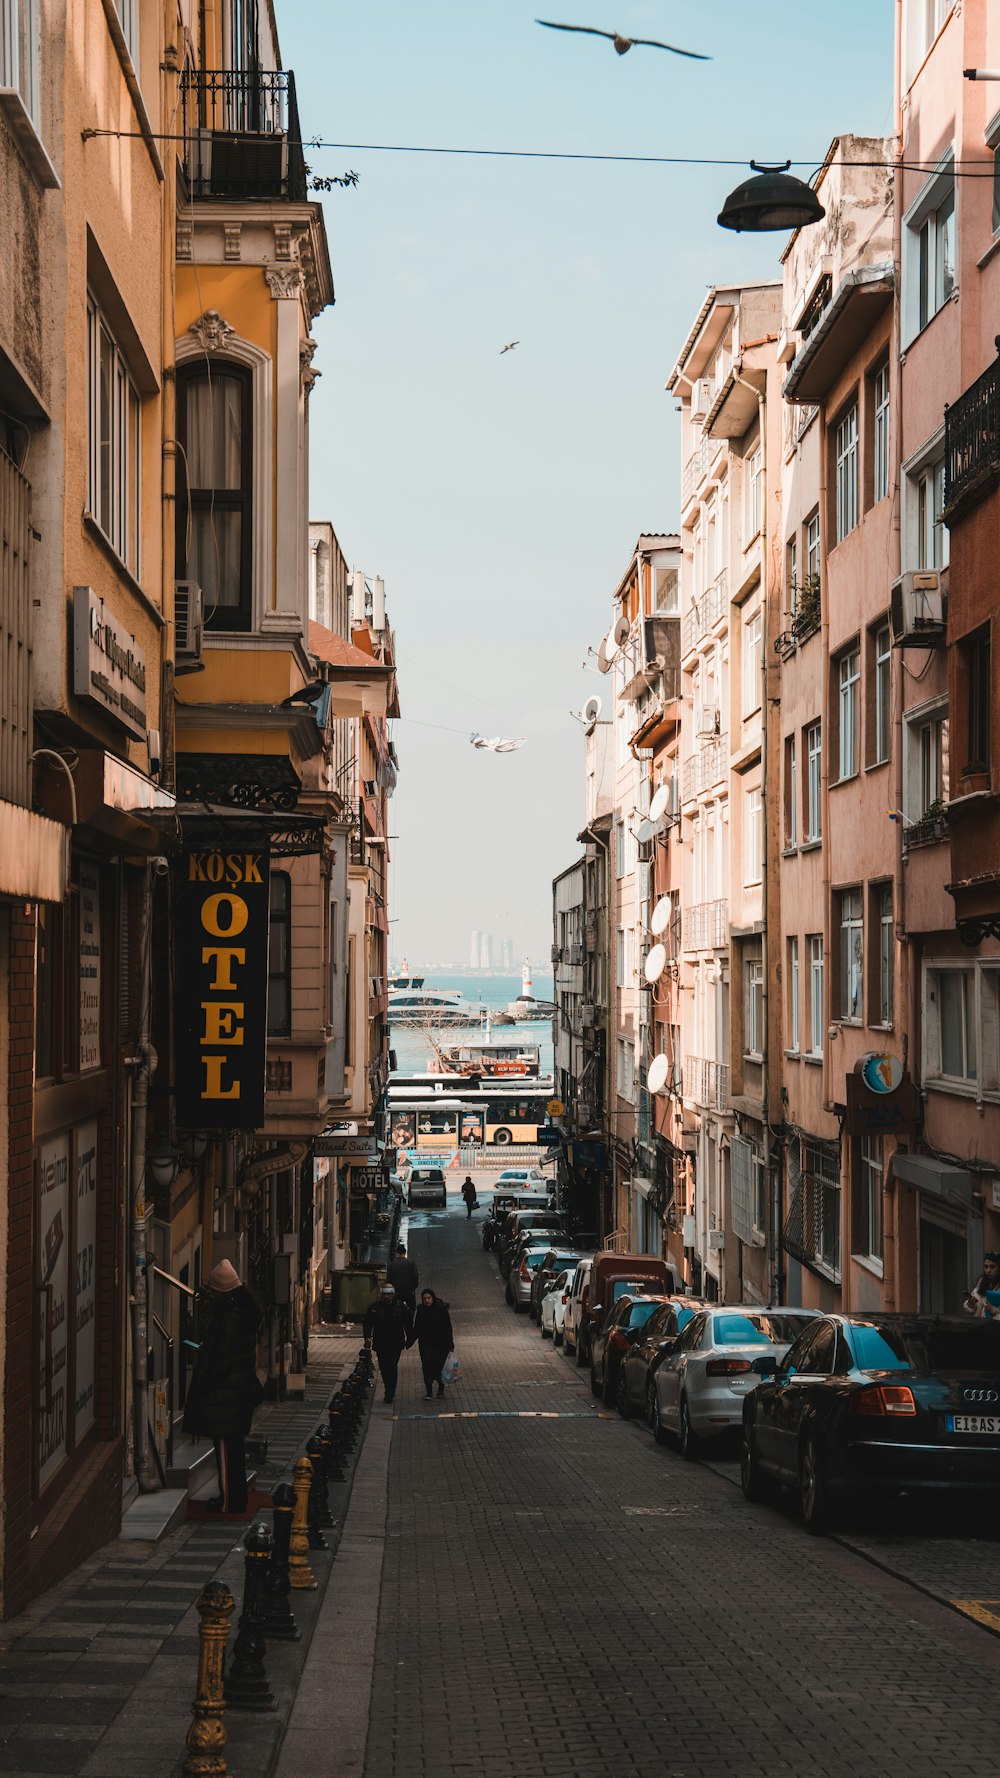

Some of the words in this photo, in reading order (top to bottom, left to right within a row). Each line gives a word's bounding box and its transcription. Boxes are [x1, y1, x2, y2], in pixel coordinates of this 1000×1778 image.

[188, 848, 264, 889] KÖŞK
[199, 893, 249, 1100] OTEL
[348, 1140, 374, 1152] Suite
[351, 1173, 388, 1188] HOTEL
[955, 1417, 969, 1431] EI
[979, 1418, 995, 1432] AS
